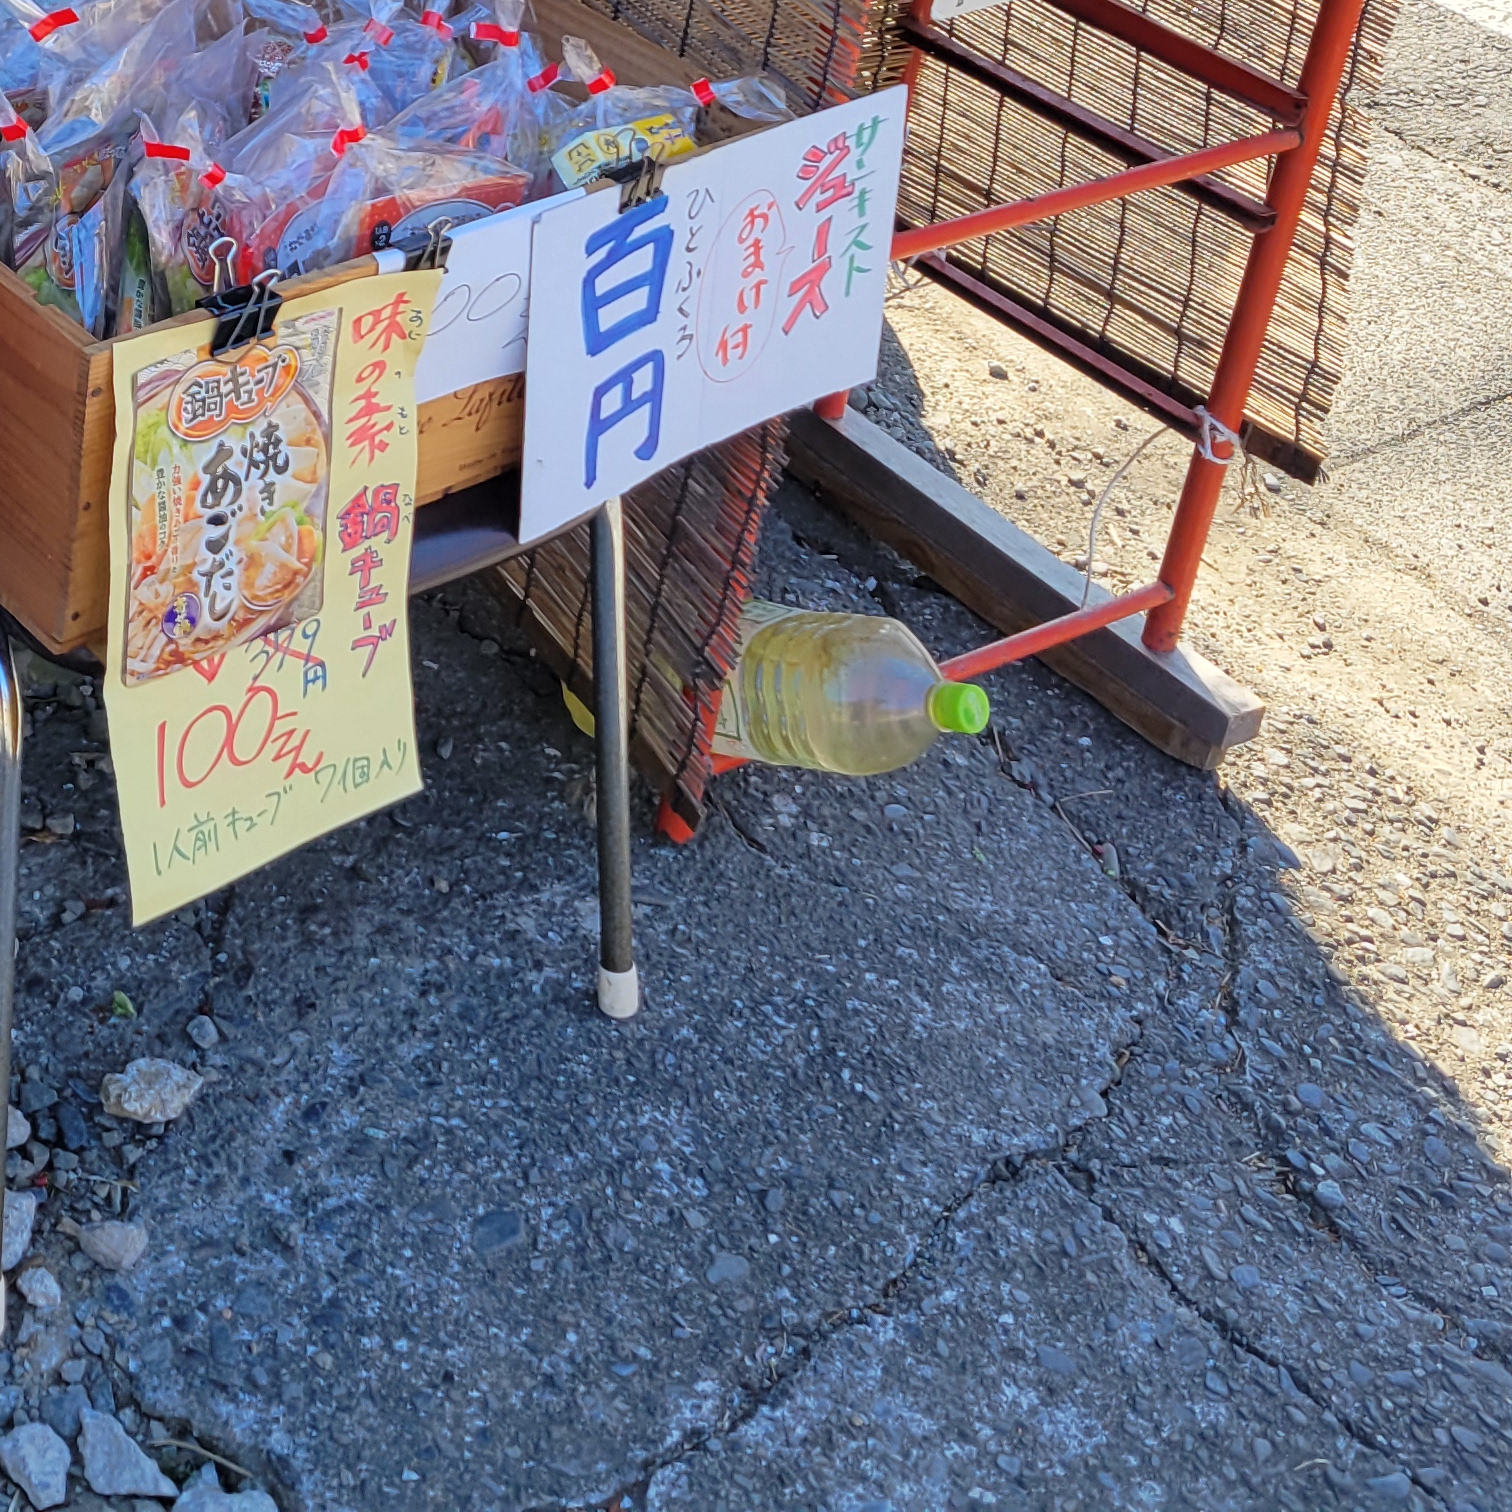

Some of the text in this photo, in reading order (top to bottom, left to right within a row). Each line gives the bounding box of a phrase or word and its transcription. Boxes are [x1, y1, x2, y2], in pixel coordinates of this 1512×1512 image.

[716, 203, 774, 369] おまけ付
[781, 131, 857, 336] ジュース
[182, 353, 291, 428] 鍋キューブ
[344, 297, 412, 468] 味の素
[580, 193, 675, 489] 百円
[197, 440, 244, 622] あごだし
[241, 419, 291, 516] 焼き
[337, 482, 401, 678] 鍋キューブ
